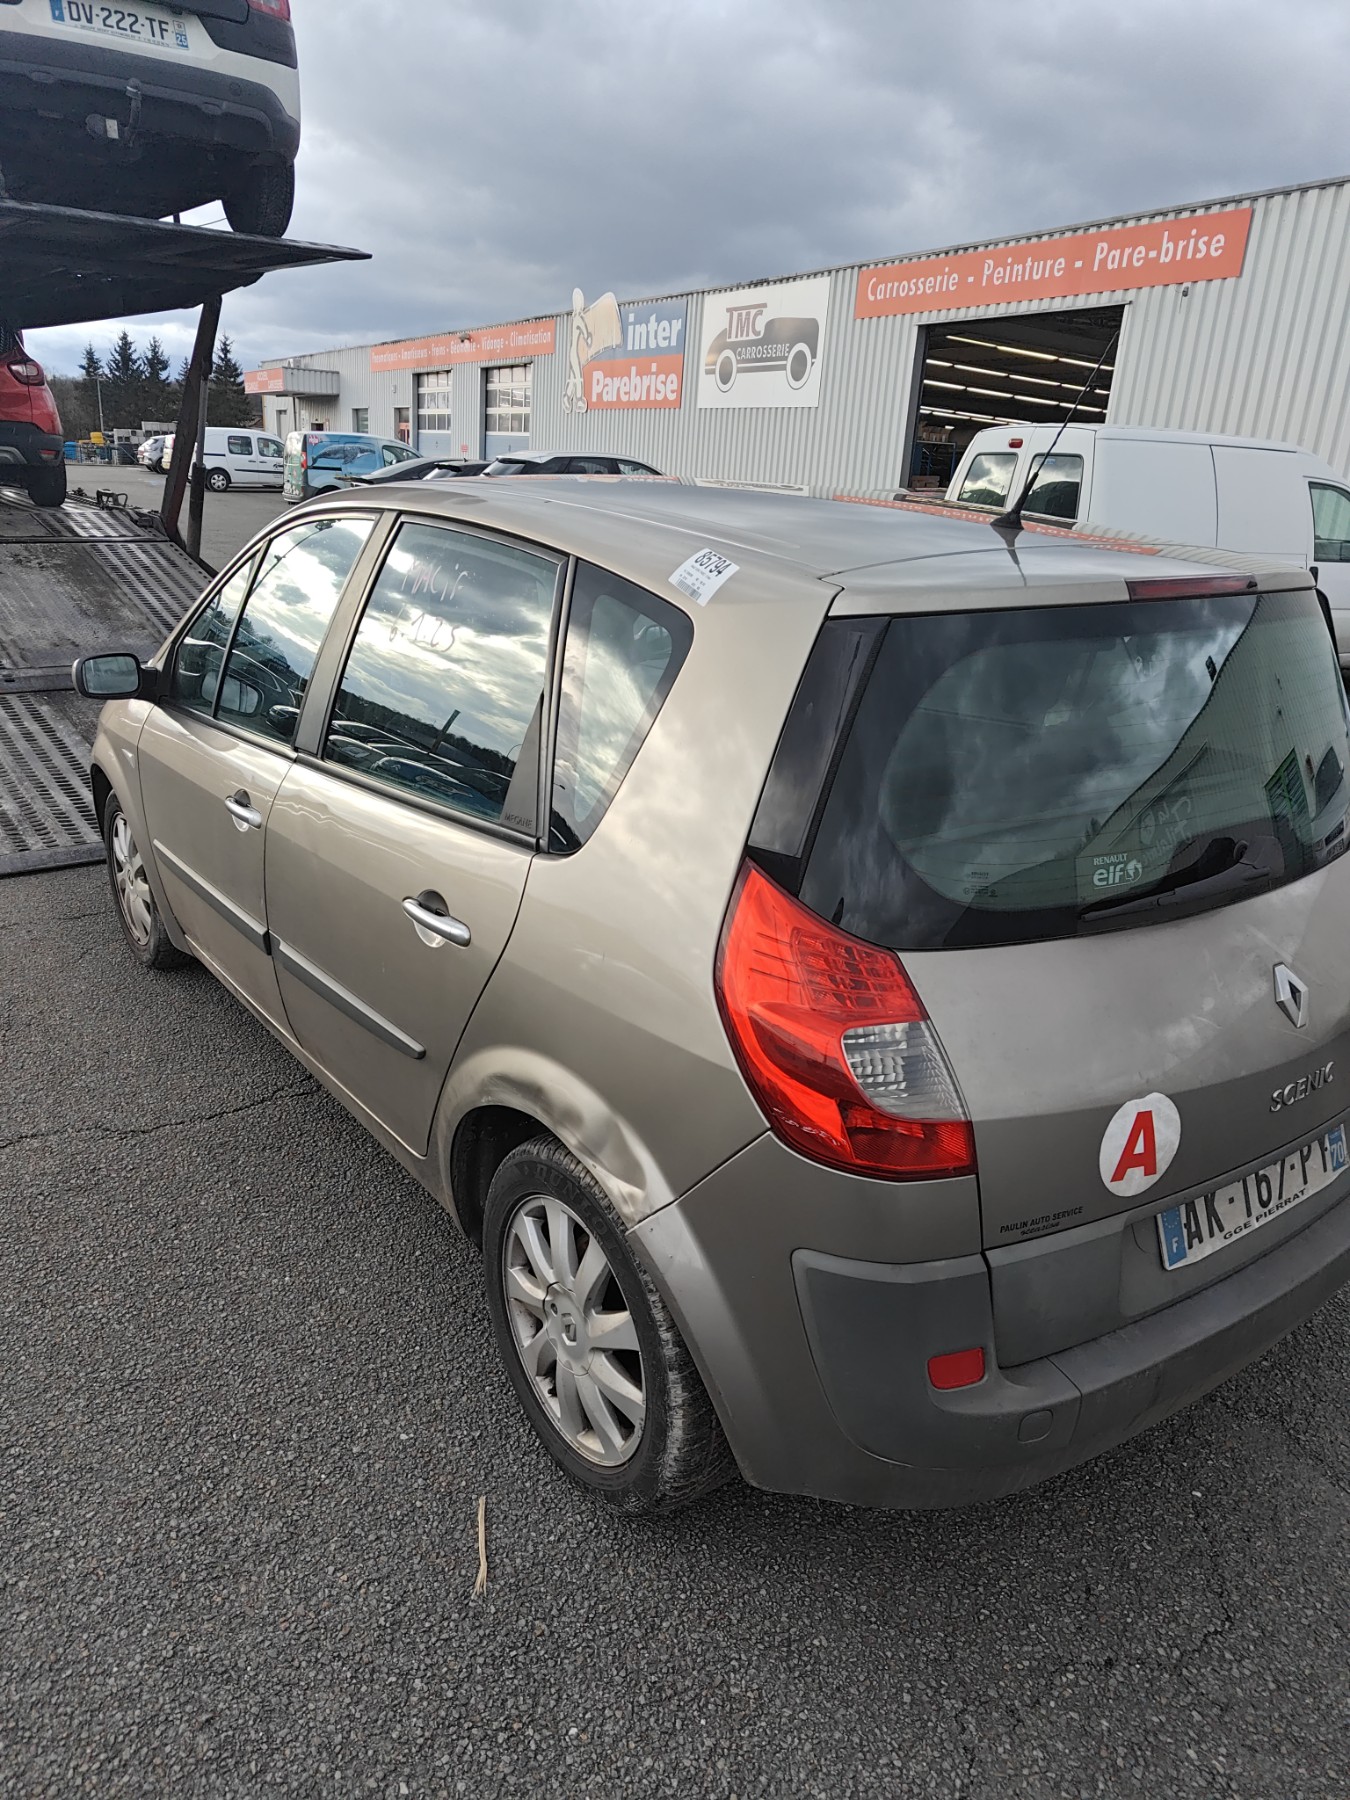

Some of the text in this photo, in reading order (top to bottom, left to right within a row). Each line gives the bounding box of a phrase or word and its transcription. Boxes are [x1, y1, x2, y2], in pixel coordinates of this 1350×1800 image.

[67, 1, 169, 40] DV-222-TF
[176, 34, 188, 46] 25
[867, 268, 959, 302] Carrosserie
[982, 257, 1067, 287] Peinture
[1093, 229, 1226, 272] Pare-brise
[627, 313, 682, 351] inter
[726, 303, 768, 341] TMC
[735, 343, 791, 360] CARROSSERIE
[591, 362, 678, 402] Parebrise
[694, 551, 732, 577] 85794
[1092, 863, 1125, 886] elf
[1093, 853, 1128, 866] RENAULT
[1269, 1061, 1335, 1112] SCENIC
[1110, 1110, 1157, 1183] A
[999, 1220, 1029, 1234] PAULIN
[1030, 1215, 1051, 1227] AUTO
[1052, 1206, 1084, 1221] SERVICE
[1223, 1188, 1307, 1240] GGE PIERRAT
